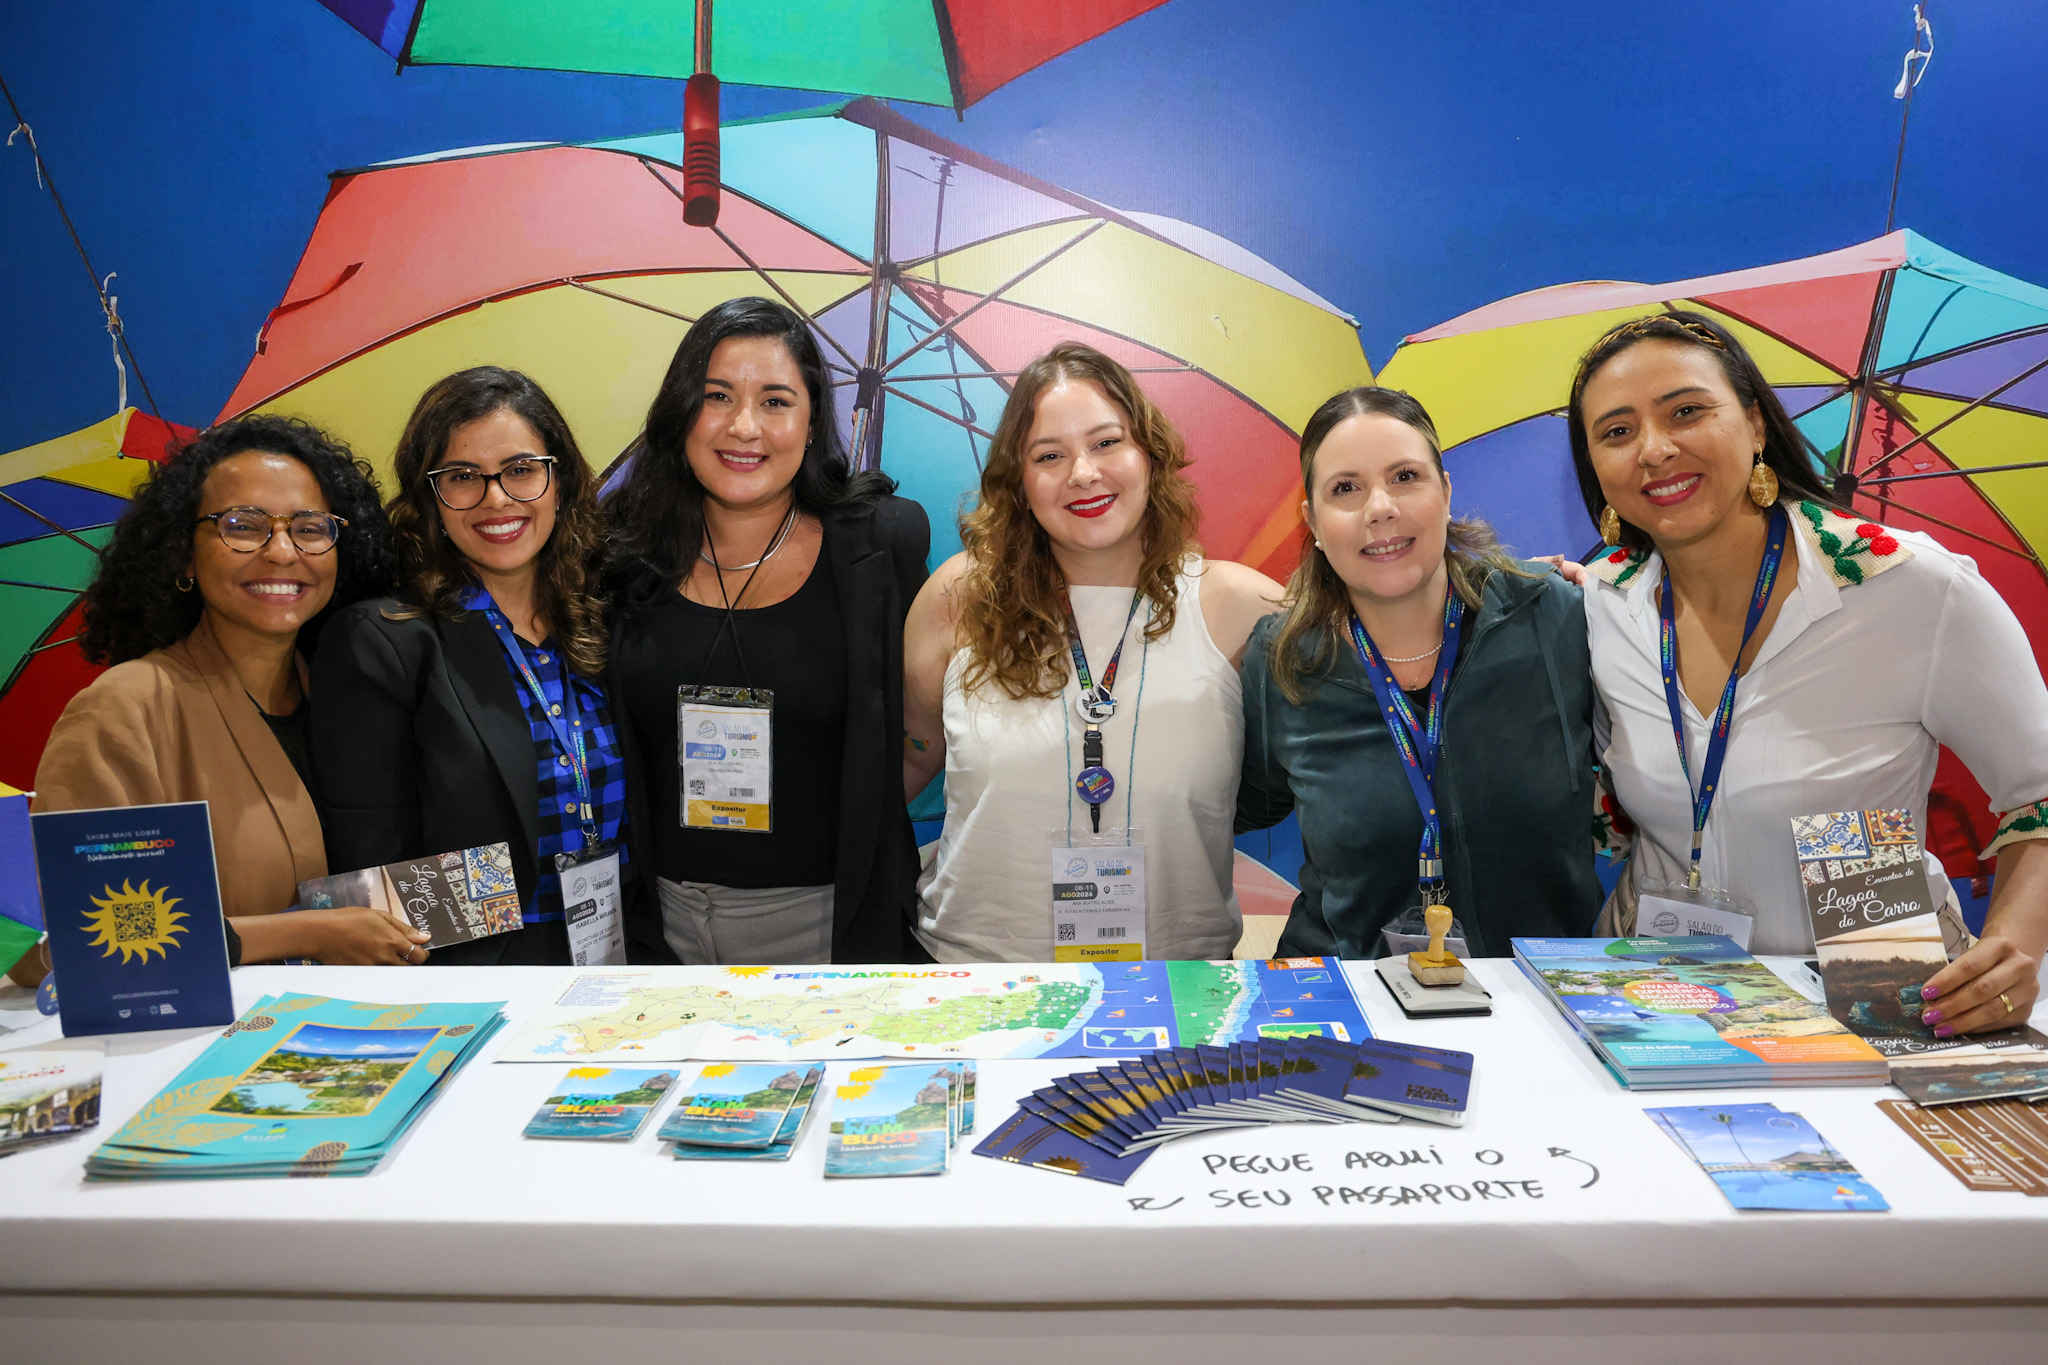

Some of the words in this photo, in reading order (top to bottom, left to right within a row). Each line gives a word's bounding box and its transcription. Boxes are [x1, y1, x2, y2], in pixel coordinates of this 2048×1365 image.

[712, 804, 746, 813] Expositor
[135, 829, 160, 837] SOBRE
[75, 838, 175, 854] PERNAMBUCO
[1096, 867, 1127, 876] TURISMO
[1865, 871, 1904, 886] Encantos
[1905, 868, 1915, 877] de
[410, 864, 438, 908] Lagoa
[1817, 887, 1877, 915] Lagoa
[1861, 900, 1921, 923] Carro
[1686, 920, 1711, 932] SALÃO
[1713, 924, 1724, 934] DO
[1839, 913, 1856, 929] do
[1081, 948, 1119, 957] Expositor
[773, 971, 971, 980] PERNAMBUCO
[1902, 1040, 1961, 1052] Carro
[555, 1104, 624, 1113] BUCO
[685, 1107, 756, 1118] BUCO
[844, 1123, 904, 1135] NAM
[842, 1132, 918, 1146] BUCO
[1202, 1151, 1314, 1175] PEGUE
[1475, 1149, 1505, 1166] O
[1208, 1187, 1292, 1209] SEU
[1311, 1179, 1545, 1207] PASSAPORTE
